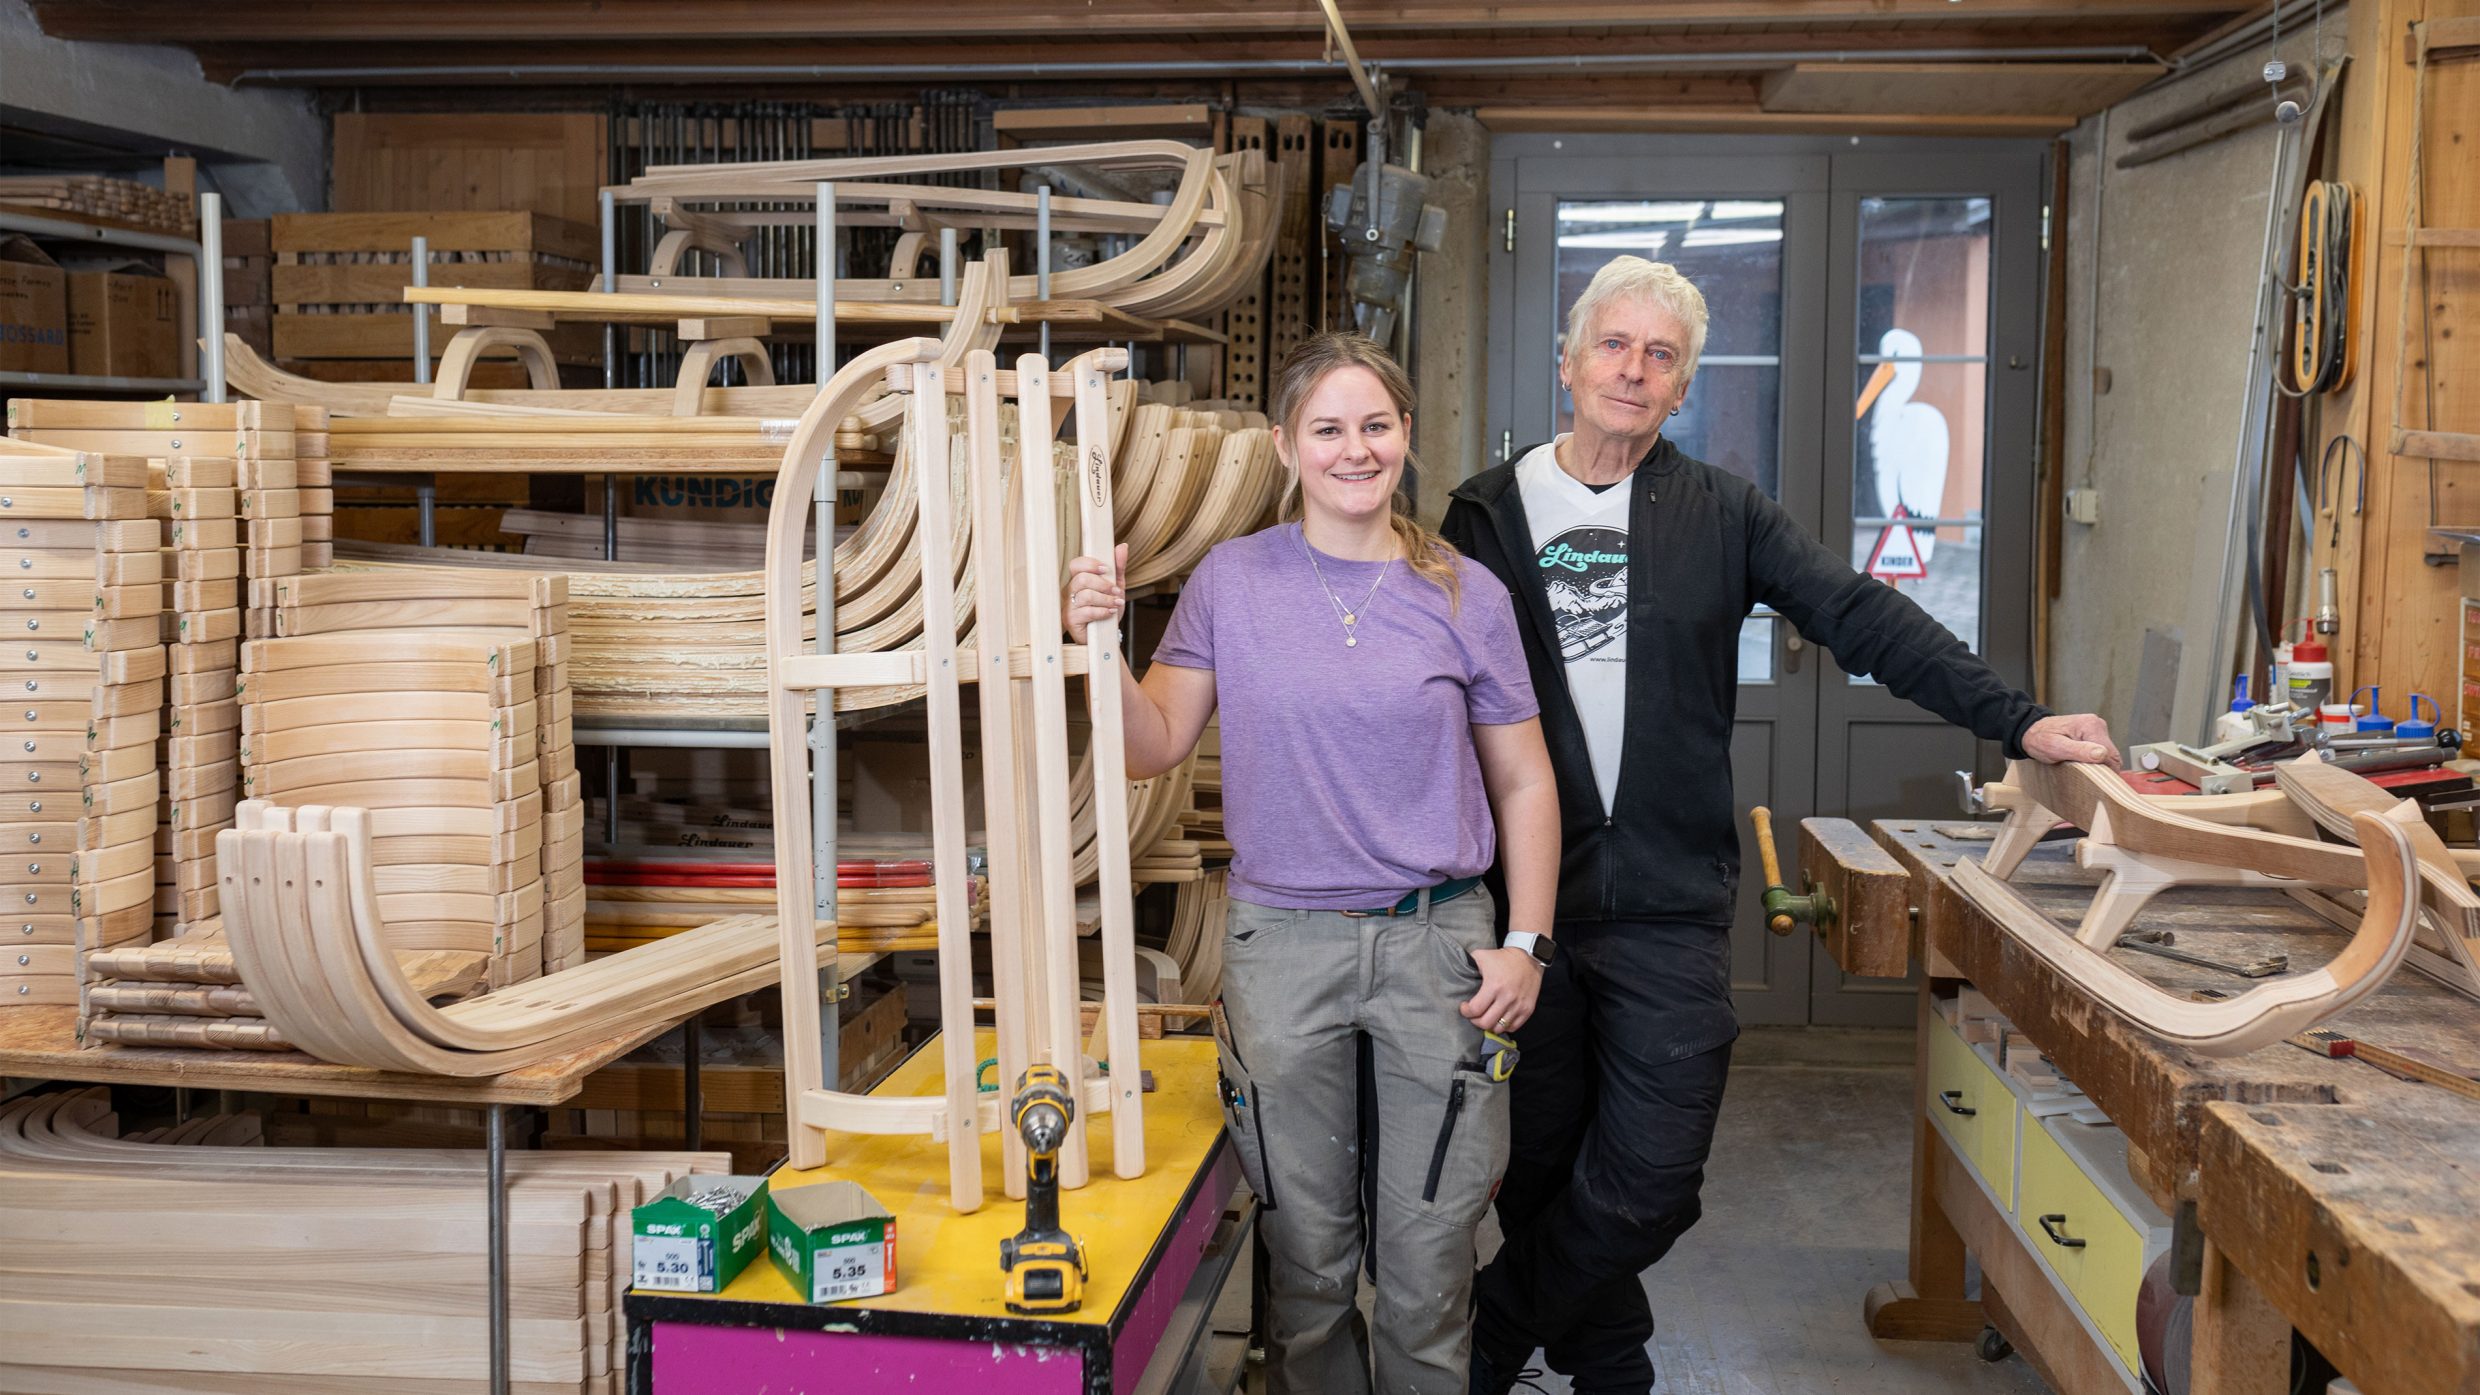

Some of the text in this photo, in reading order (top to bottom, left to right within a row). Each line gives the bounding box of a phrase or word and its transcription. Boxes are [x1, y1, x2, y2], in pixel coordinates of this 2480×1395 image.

[711, 814, 774, 830] Lindaue
[678, 833, 754, 849] Lindauer
[646, 1223, 684, 1236] SPAX
[831, 1231, 868, 1245] SPAX
